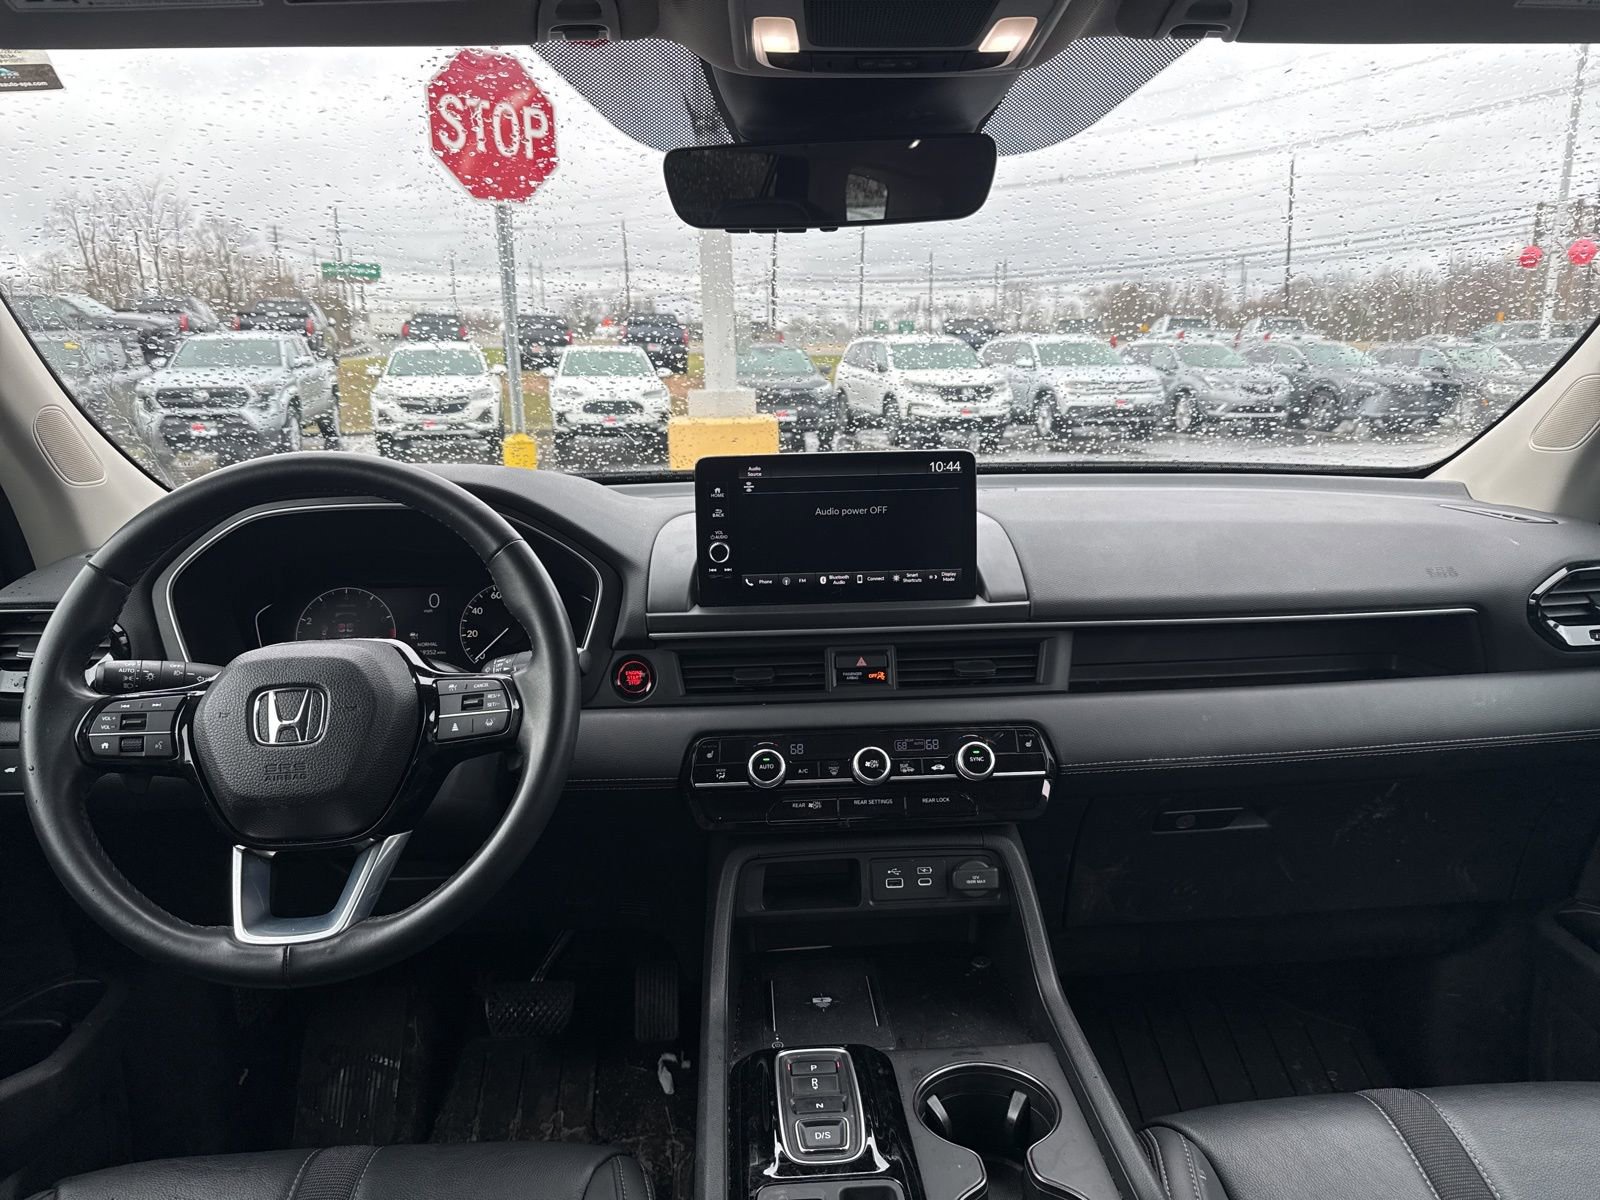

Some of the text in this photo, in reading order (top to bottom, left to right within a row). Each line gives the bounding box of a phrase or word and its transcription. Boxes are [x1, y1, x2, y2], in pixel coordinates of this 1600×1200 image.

[439, 93, 548, 159] STOP
[929, 461, 961, 472] 10:44
[815, 505, 888, 517] Audio power OFF
[429, 593, 440, 608] 0
[790, 743, 804, 754] 68
[896, 741, 907, 750] 68
[925, 738, 940, 750] 68
[811, 1078, 818, 1086] R
[814, 1131, 831, 1140] D/S
